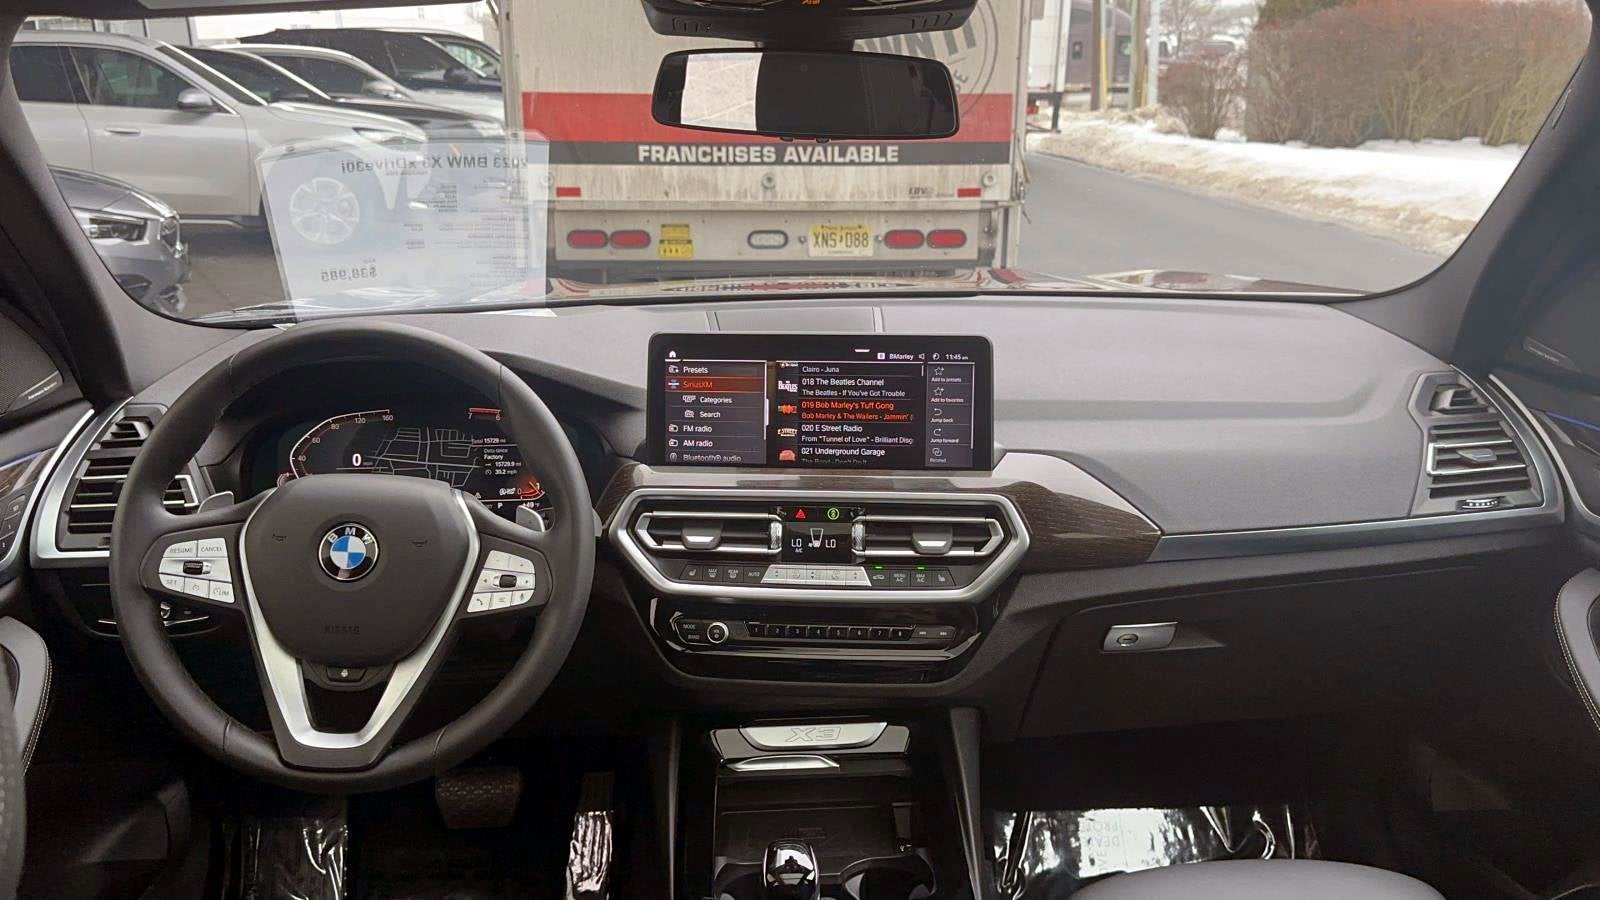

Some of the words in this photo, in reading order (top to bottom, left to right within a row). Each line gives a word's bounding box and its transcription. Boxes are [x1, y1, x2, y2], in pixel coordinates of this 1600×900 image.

[638, 145, 776, 163] FRANCHISES
[783, 145, 899, 163] AVAILABLE
[683, 366, 708, 374] Presets
[881, 389, 906, 397] Trouble
[699, 396, 732, 404] Categories
[830, 402, 859, 410] Marley's
[875, 402, 894, 410] Gong
[821, 424, 842, 432] Street
[814, 448, 859, 456] Underground
[860, 448, 885, 456] Garage
[352, 453, 362, 467] 0
[327, 527, 373, 545] BMW
[791, 538, 802, 548] LO
[825, 538, 837, 548] LO
[784, 725, 842, 742] X3
